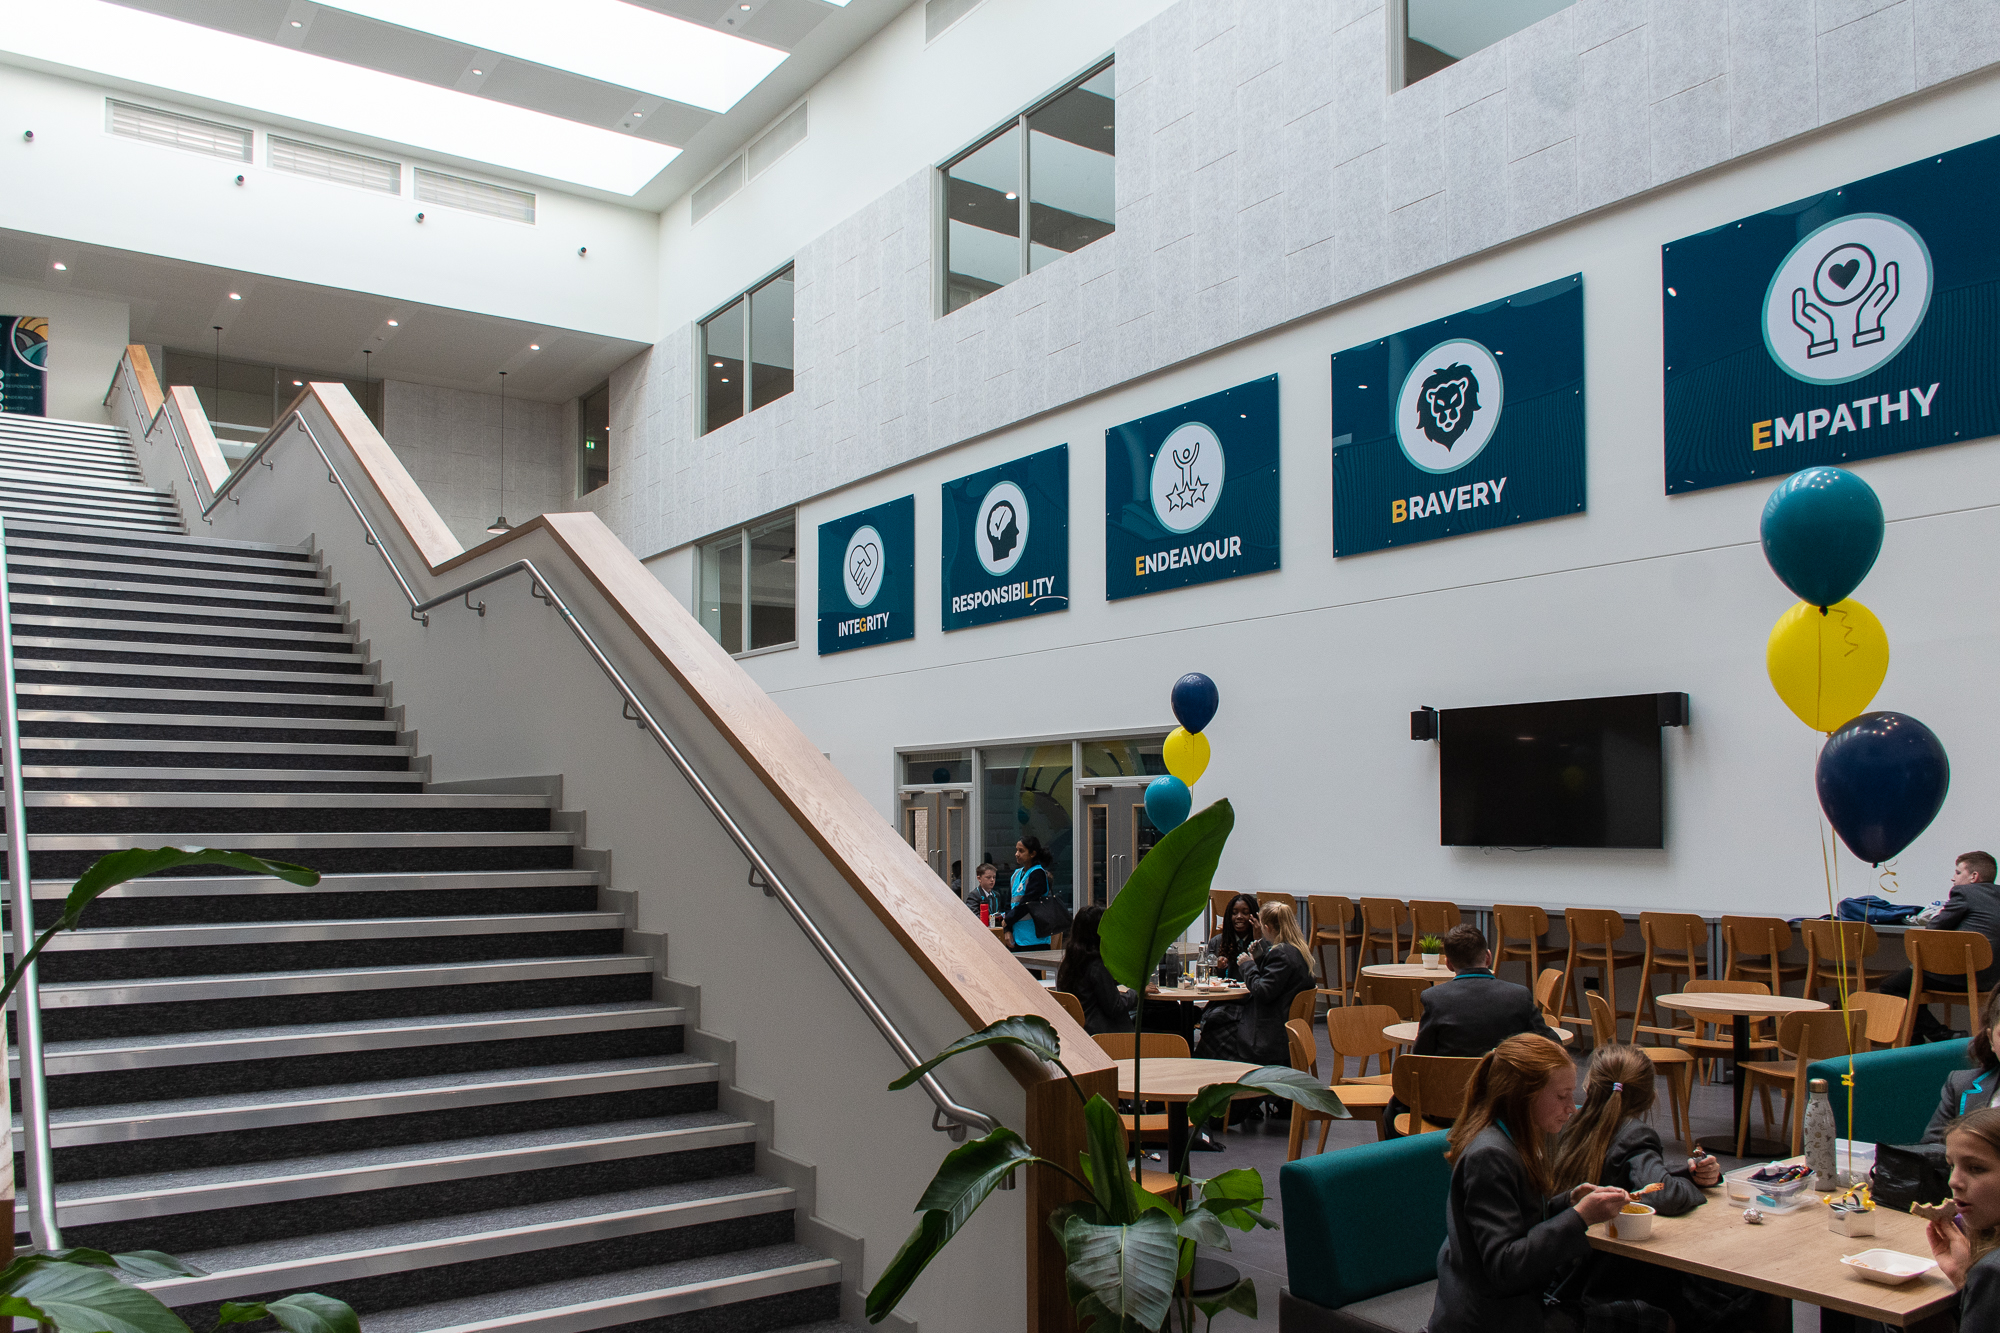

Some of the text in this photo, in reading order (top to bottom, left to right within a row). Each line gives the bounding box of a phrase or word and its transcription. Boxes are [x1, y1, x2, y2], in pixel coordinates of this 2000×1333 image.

[1752, 382, 1941, 452] EMPATHY
[1392, 475, 1508, 525] BRAVERY
[1135, 535, 1242, 576] ENDEAVOUR
[952, 575, 1056, 614] RESPONSIBILITY
[838, 611, 891, 638] INTEGRITY
